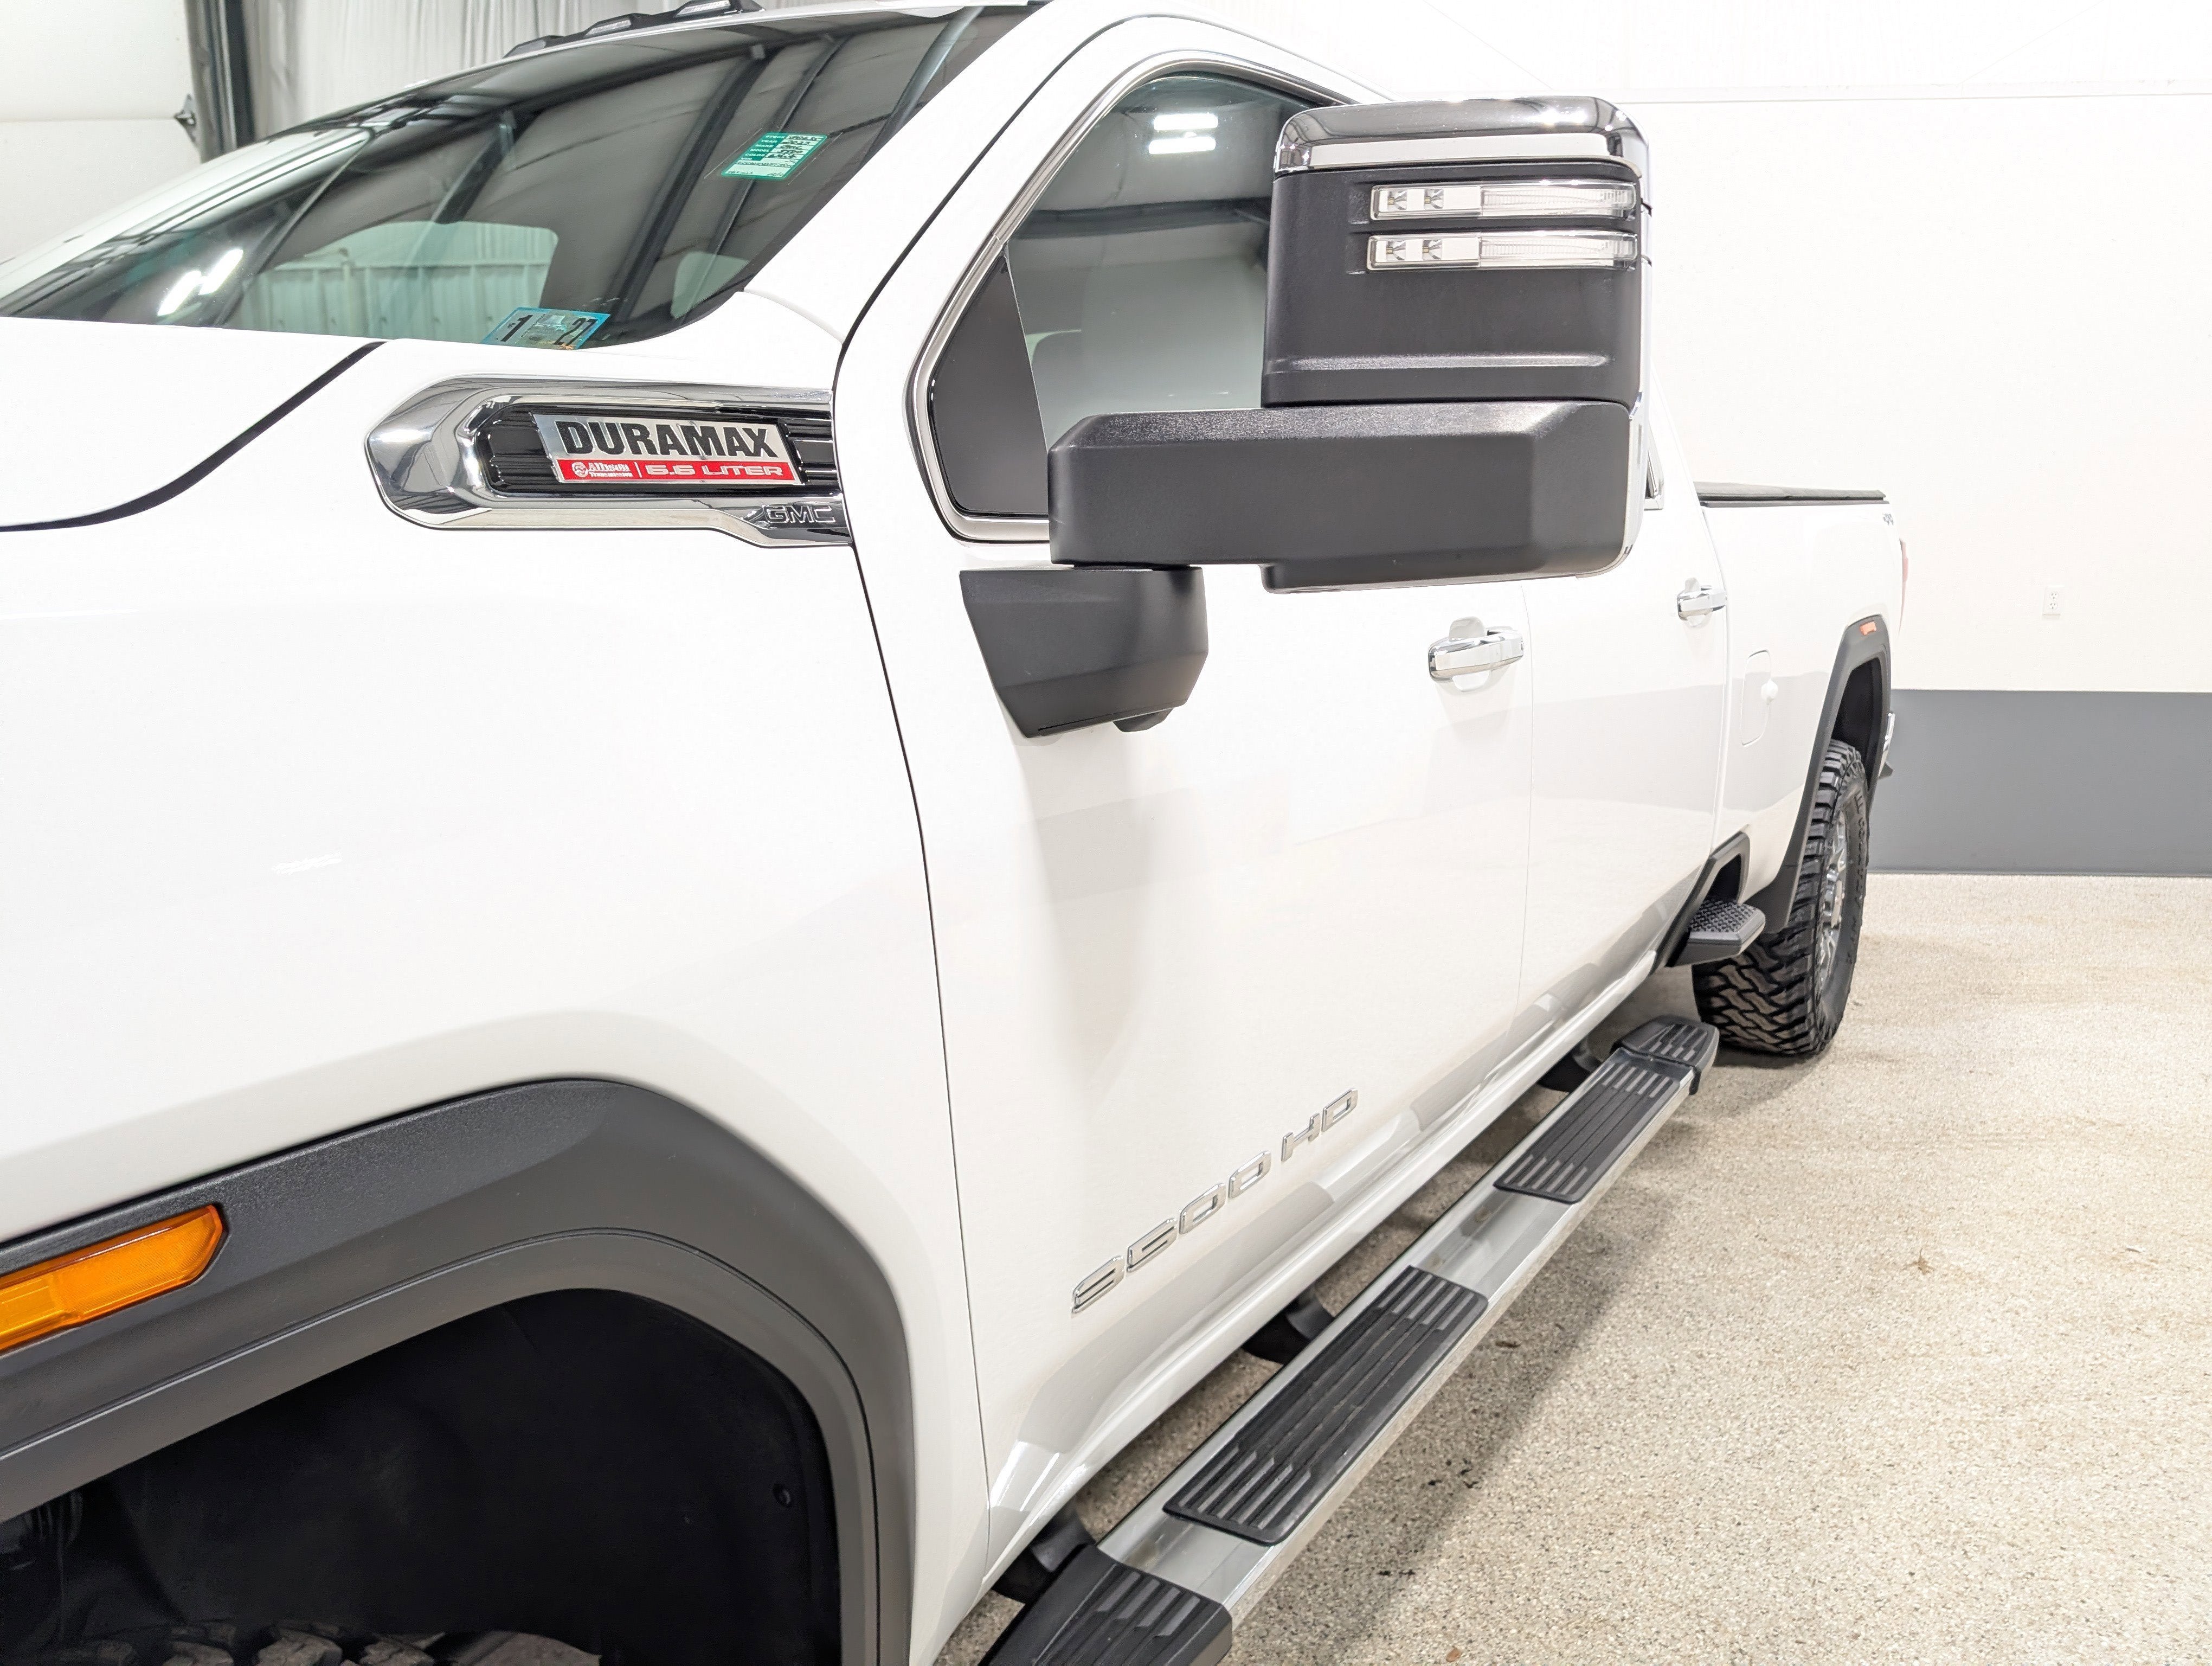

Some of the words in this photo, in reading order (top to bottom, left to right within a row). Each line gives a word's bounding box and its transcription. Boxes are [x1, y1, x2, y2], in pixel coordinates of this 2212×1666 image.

[500, 315, 533, 342] 1
[553, 317, 599, 346] 27
[555, 420, 778, 458] DURAMAX
[645, 465, 696, 476] 6.6
[702, 465, 783, 476] LITER
[763, 505, 835, 523] GMC
[1071, 1150, 1272, 1315] 3500
[1281, 1087, 1358, 1162] HD
